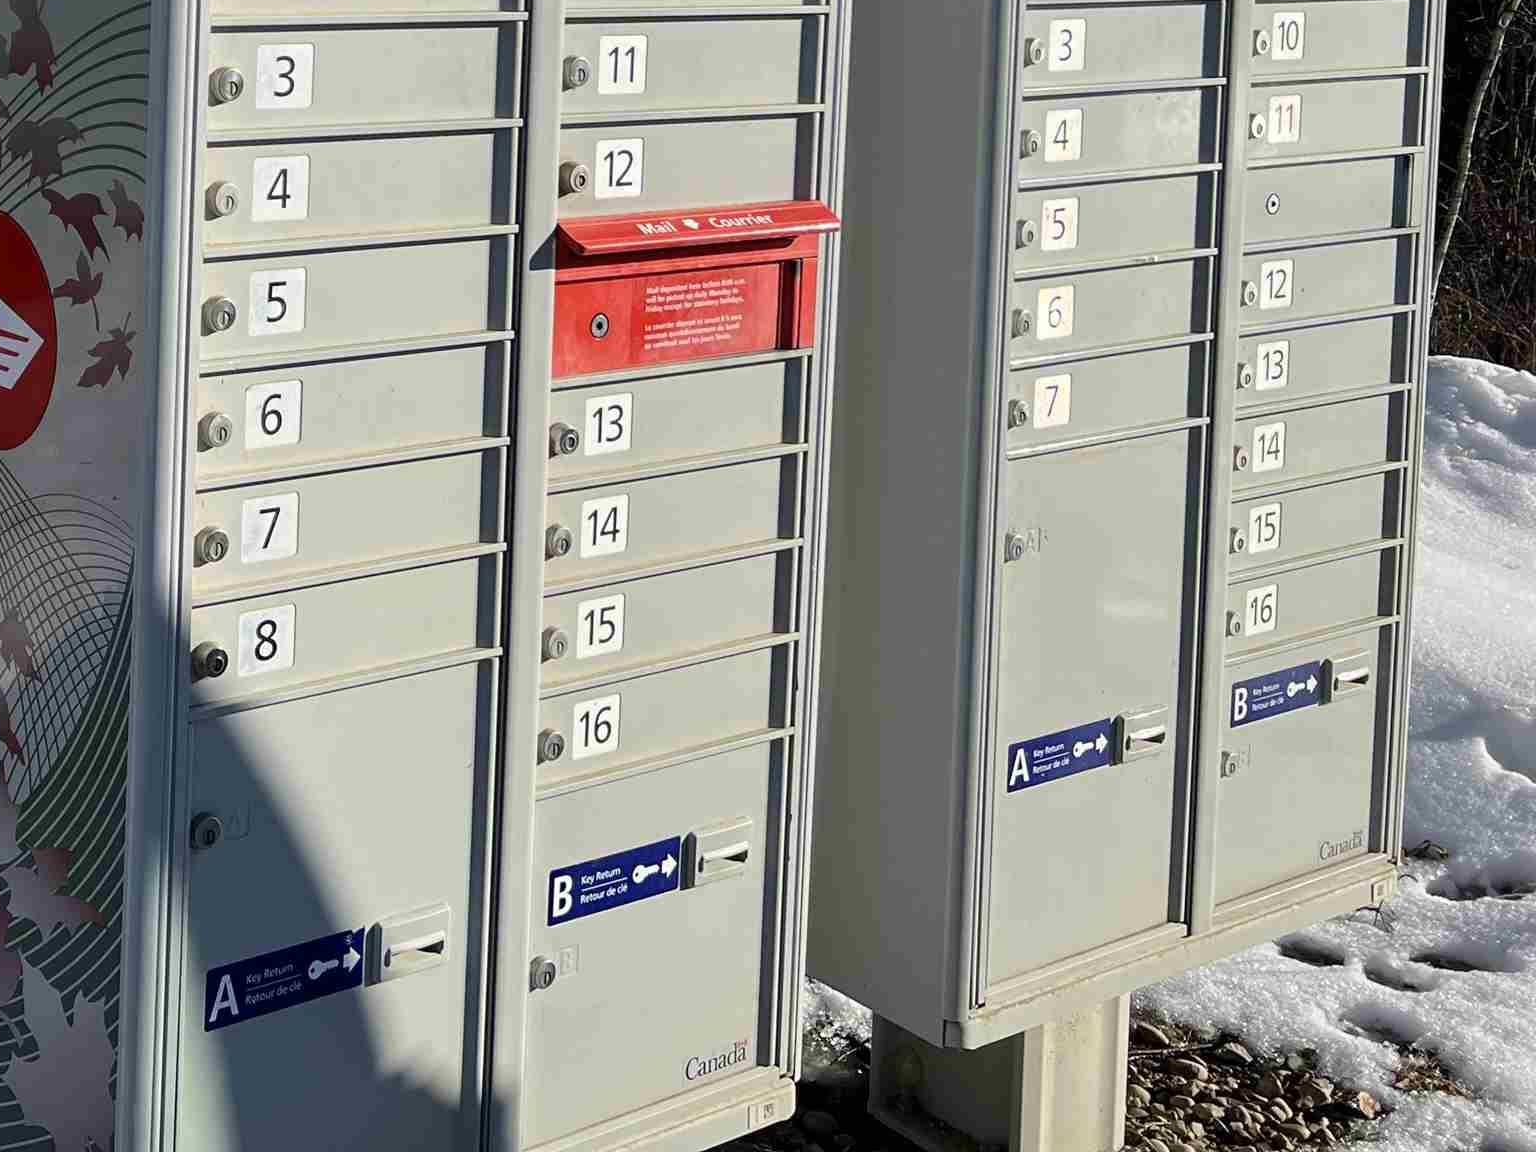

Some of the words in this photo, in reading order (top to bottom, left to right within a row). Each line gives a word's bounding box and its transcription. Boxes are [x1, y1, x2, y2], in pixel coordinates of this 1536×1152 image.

[1058, 28, 1073, 62] 3
[1277, 20, 1300, 52] 10
[273, 55, 296, 98] 3
[608, 46, 635, 84] 11
[1052, 119, 1070, 151] 4
[1274, 103, 1294, 135] 11
[603, 149, 634, 188] 12
[266, 168, 292, 209] 4
[636, 221, 676, 236] Mail
[710, 212, 775, 229] Courrier
[1052, 207, 1066, 241] 5
[1266, 268, 1287, 300] 12
[266, 280, 287, 323] 5
[1047, 295, 1063, 329] 6
[1262, 349, 1284, 381] 13
[260, 393, 283, 436] 6
[1045, 384, 1059, 417] 7
[592, 404, 624, 444] 13
[1257, 431, 1281, 464] 14
[258, 506, 281, 550] 7
[587, 506, 621, 546] 14
[1254, 511, 1277, 544] 15
[584, 605, 616, 646] 15
[1250, 592, 1273, 626] 16
[254, 619, 278, 662] 8
[1233, 687, 1248, 722] B
[579, 705, 612, 748] 16
[1008, 748, 1030, 786] A
[580, 874, 595, 886] Key
[596, 867, 621, 881] Return
[552, 874, 573, 918] B
[580, 890, 605, 905] Retour
[606, 886, 616, 897] de
[245, 973, 262, 985] Key
[264, 963, 295, 979] Return
[208, 973, 240, 1023] A
[244, 990, 275, 1006] Retour
[276, 985, 288, 997] de
[686, 1041, 748, 1081] Canada
